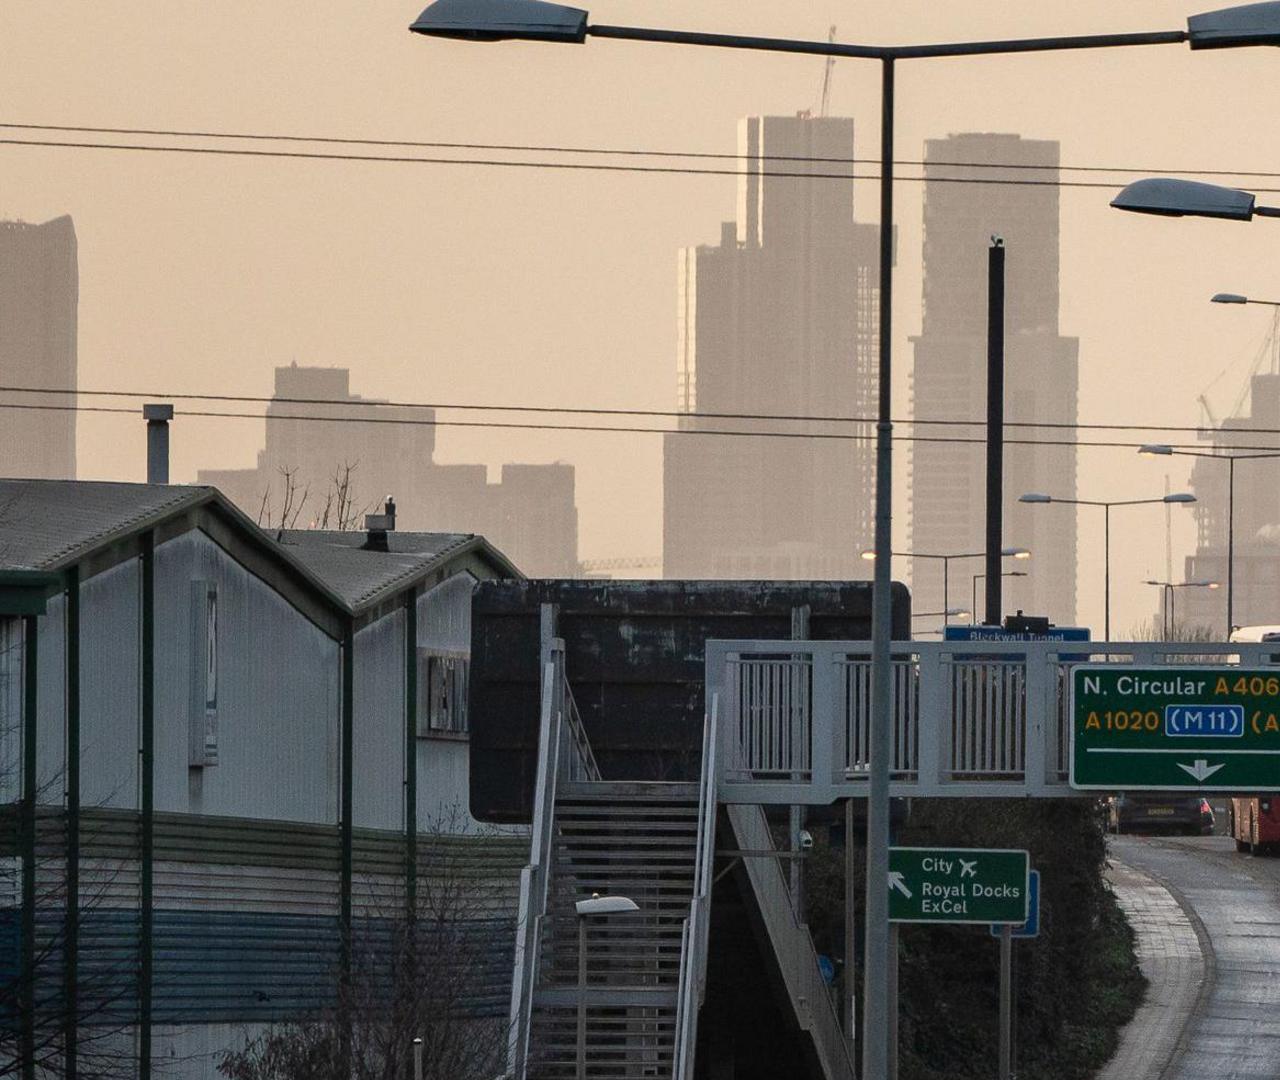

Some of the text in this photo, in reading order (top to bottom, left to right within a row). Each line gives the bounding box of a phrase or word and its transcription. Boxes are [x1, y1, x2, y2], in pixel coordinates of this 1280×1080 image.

[1083, 675, 1280, 696] N. Circular A406
[1085, 711, 1160, 730] A1020
[1170, 708, 1239, 732] (M11)
[921, 857, 953, 875] City
[921, 882, 1020, 898] Royal Docks
[921, 900, 968, 914] ExCel
